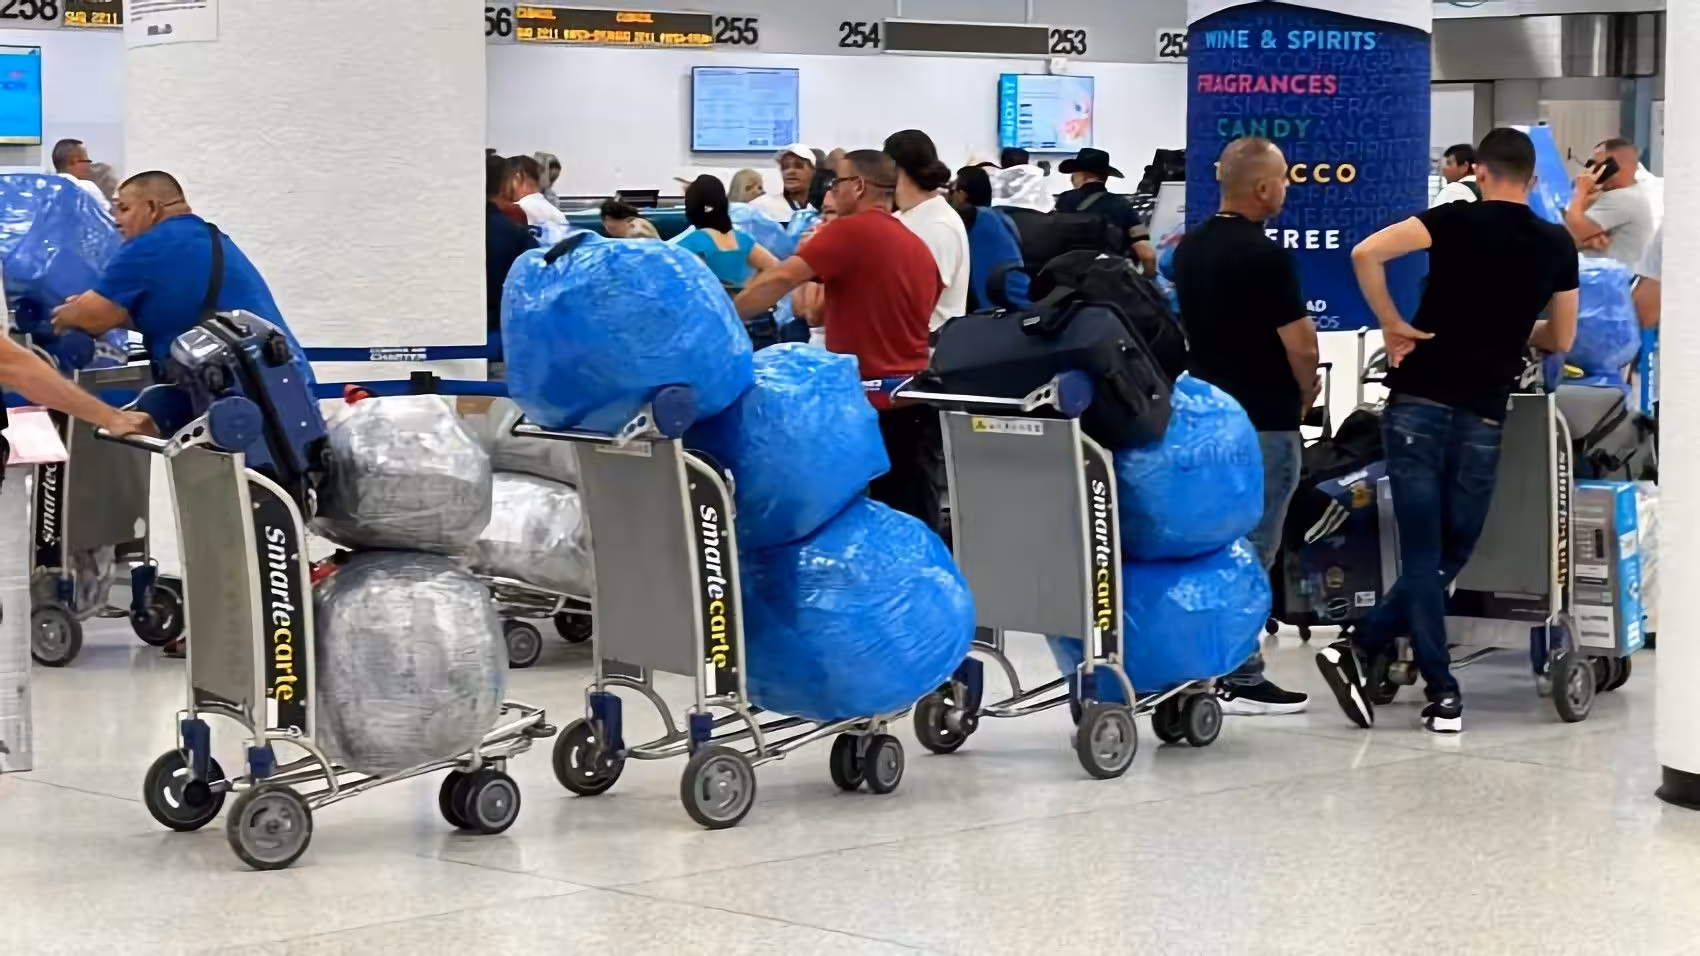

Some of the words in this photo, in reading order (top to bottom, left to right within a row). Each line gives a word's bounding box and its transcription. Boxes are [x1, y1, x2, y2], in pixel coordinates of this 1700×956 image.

[0, 0, 58, 21] 258
[485, 7, 512, 37] 56
[715, 17, 759, 44] 255
[838, 21, 881, 49] 254
[1050, 29, 1087, 55] 253
[1205, 30, 1249, 49] WINE
[1261, 30, 1277, 49] &
[1287, 30, 1376, 50] SPIRITS
[1160, 32, 1188, 57] 25
[1198, 74, 1338, 95] FRAGRANCES
[1216, 118, 1311, 138] CANDY
[1264, 229, 1340, 249] FREE
[42, 462, 57, 546] smartec
[1092, 480, 1111, 632] smartecarte
[700, 504, 729, 669] smartecarte
[265, 525, 298, 702] smartecarte
